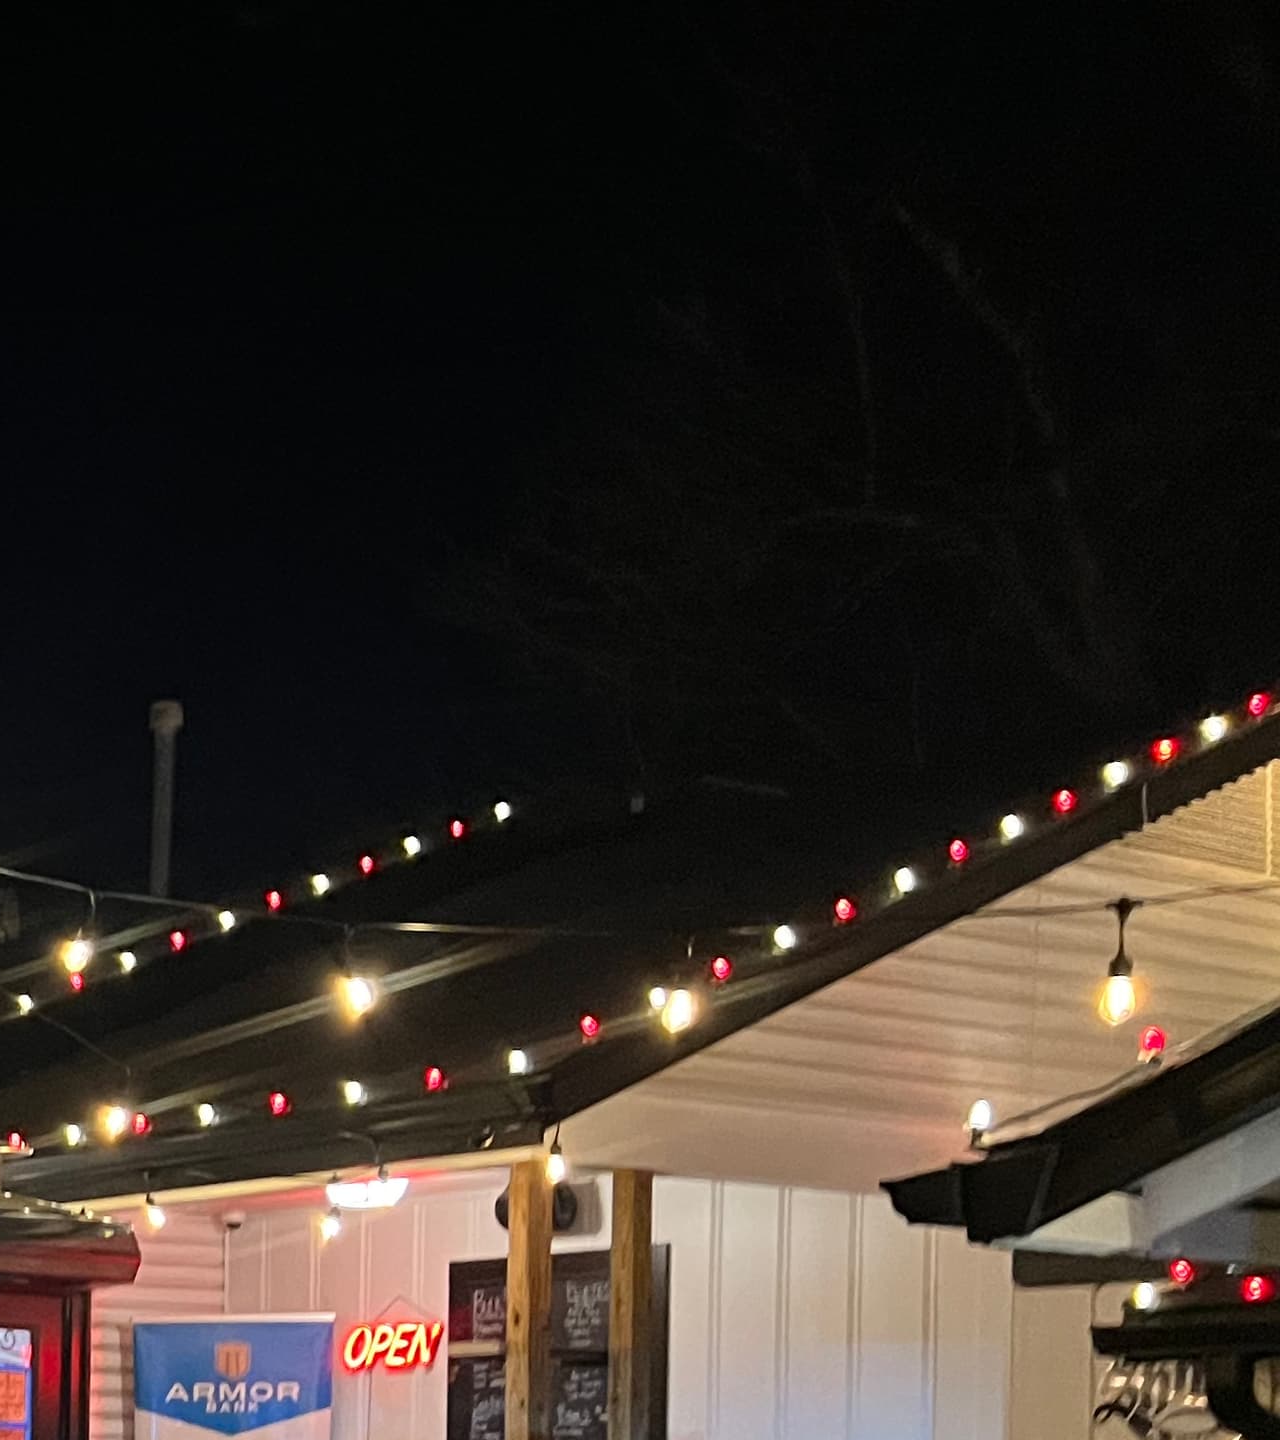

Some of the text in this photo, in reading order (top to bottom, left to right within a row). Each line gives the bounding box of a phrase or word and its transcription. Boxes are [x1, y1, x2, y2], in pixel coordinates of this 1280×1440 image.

[343, 1322, 441, 1369] OPEN
[165, 1381, 300, 1403] ARMOR
[206, 1401, 259, 1414] BANK
